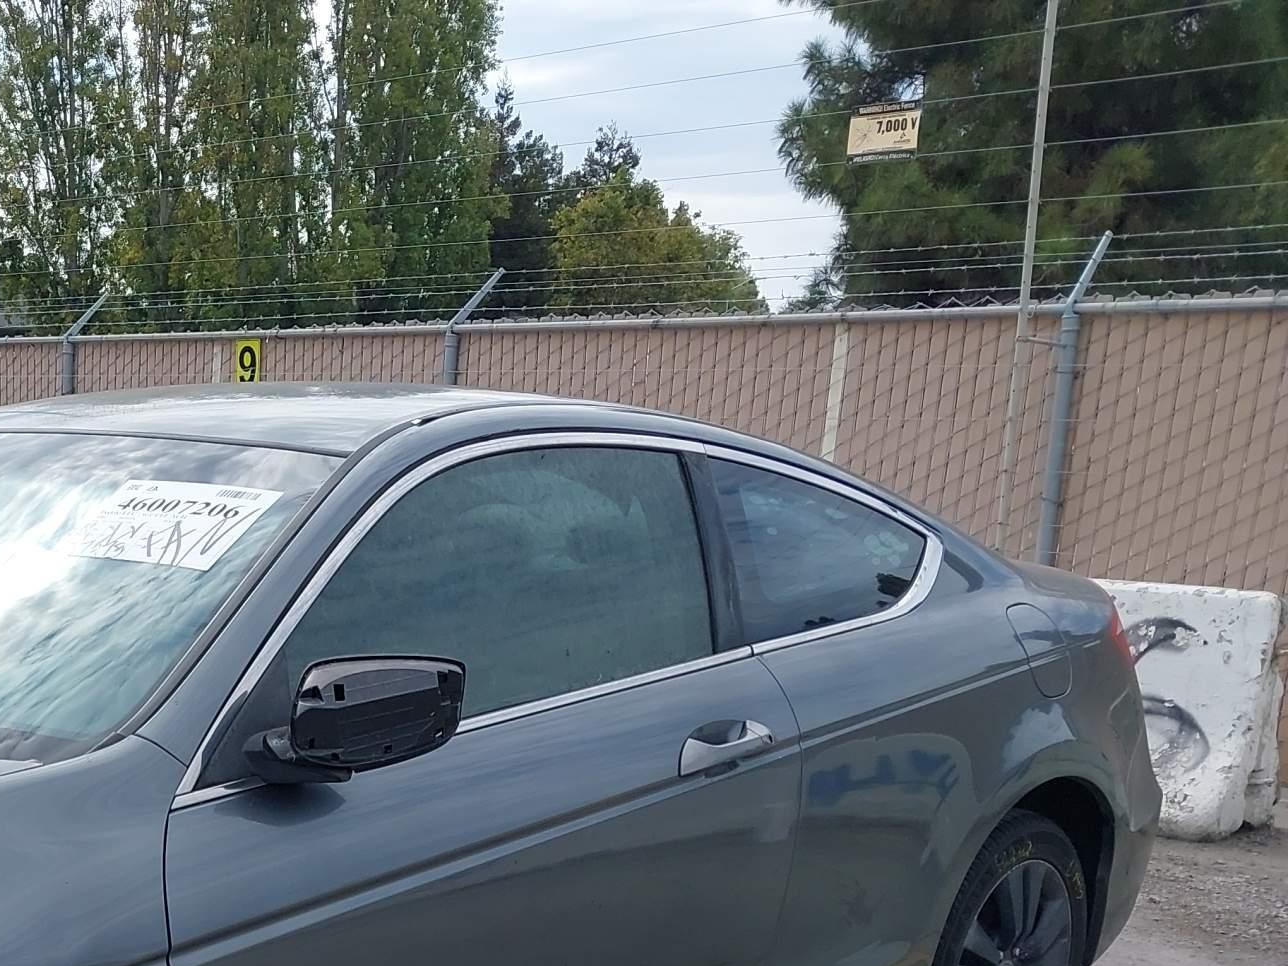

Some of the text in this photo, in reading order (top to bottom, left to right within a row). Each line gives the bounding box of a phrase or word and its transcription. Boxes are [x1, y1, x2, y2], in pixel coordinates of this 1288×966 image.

[876, 118, 908, 136] 7,000
[911, 116, 918, 130] V
[239, 345, 257, 382] 9
[118, 497, 246, 519] 46007206
